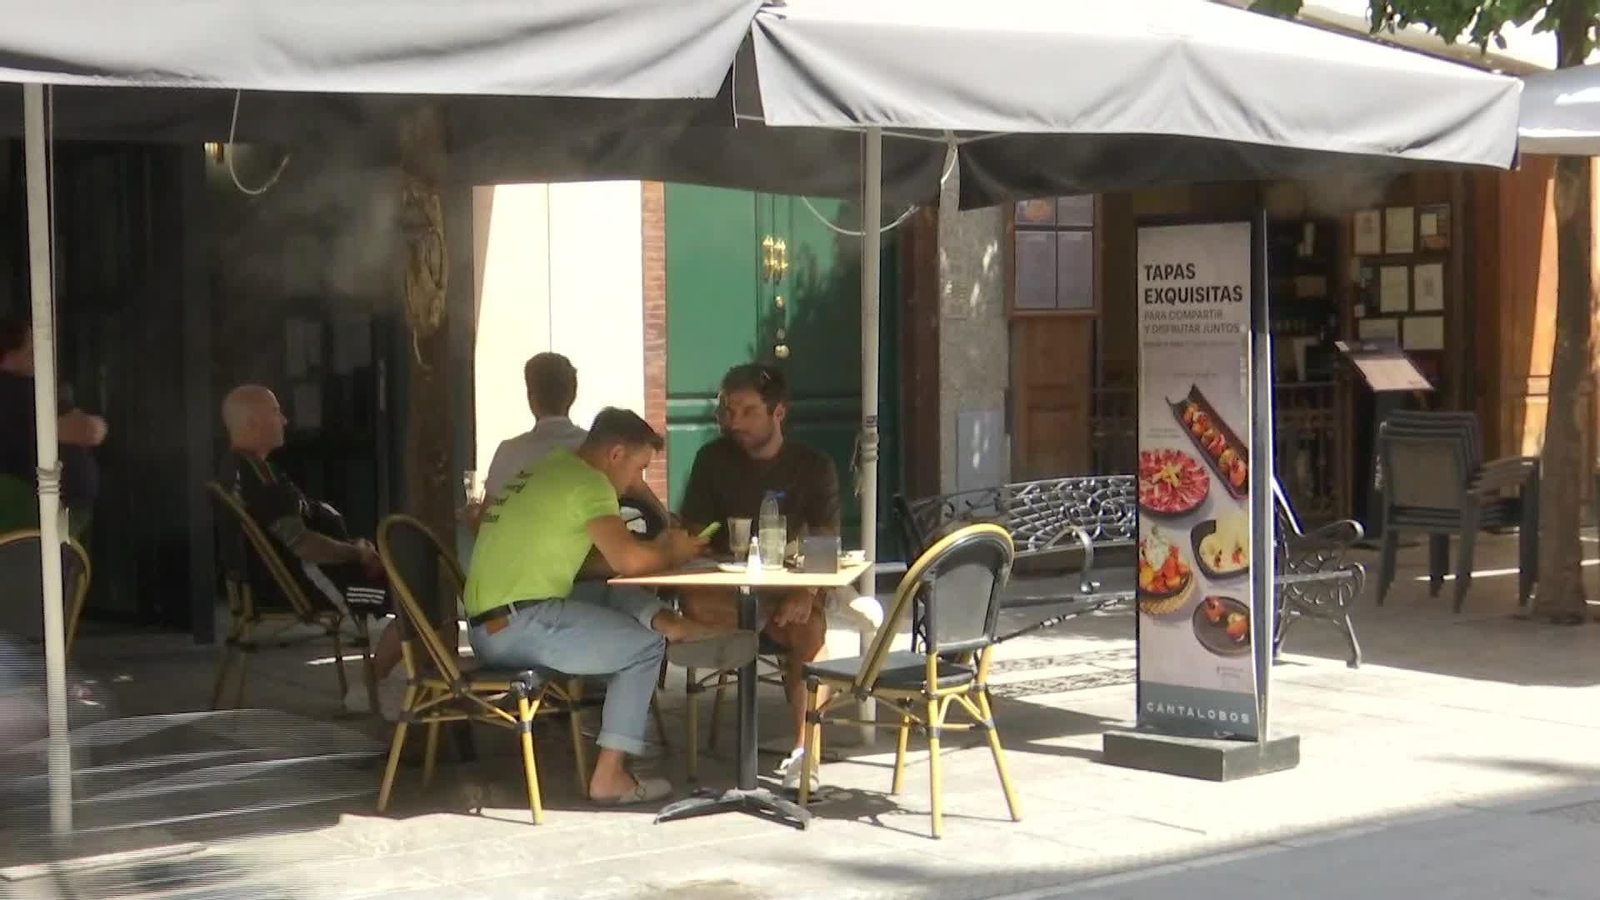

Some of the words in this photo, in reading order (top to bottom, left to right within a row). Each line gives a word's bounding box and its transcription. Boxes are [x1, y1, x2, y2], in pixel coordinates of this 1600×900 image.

[1144, 263, 1196, 281] TAPAS
[1144, 285, 1243, 305] EXQUISITAS
[1144, 311, 1167, 321] PARA
[1168, 309, 1223, 320] COMPARTIR
[1144, 324, 1151, 334] Y
[1152, 323, 1201, 334] DISFRUTAR
[1203, 322, 1240, 333] JUNTOS
[1146, 701, 1250, 725] CANTALOBOS
